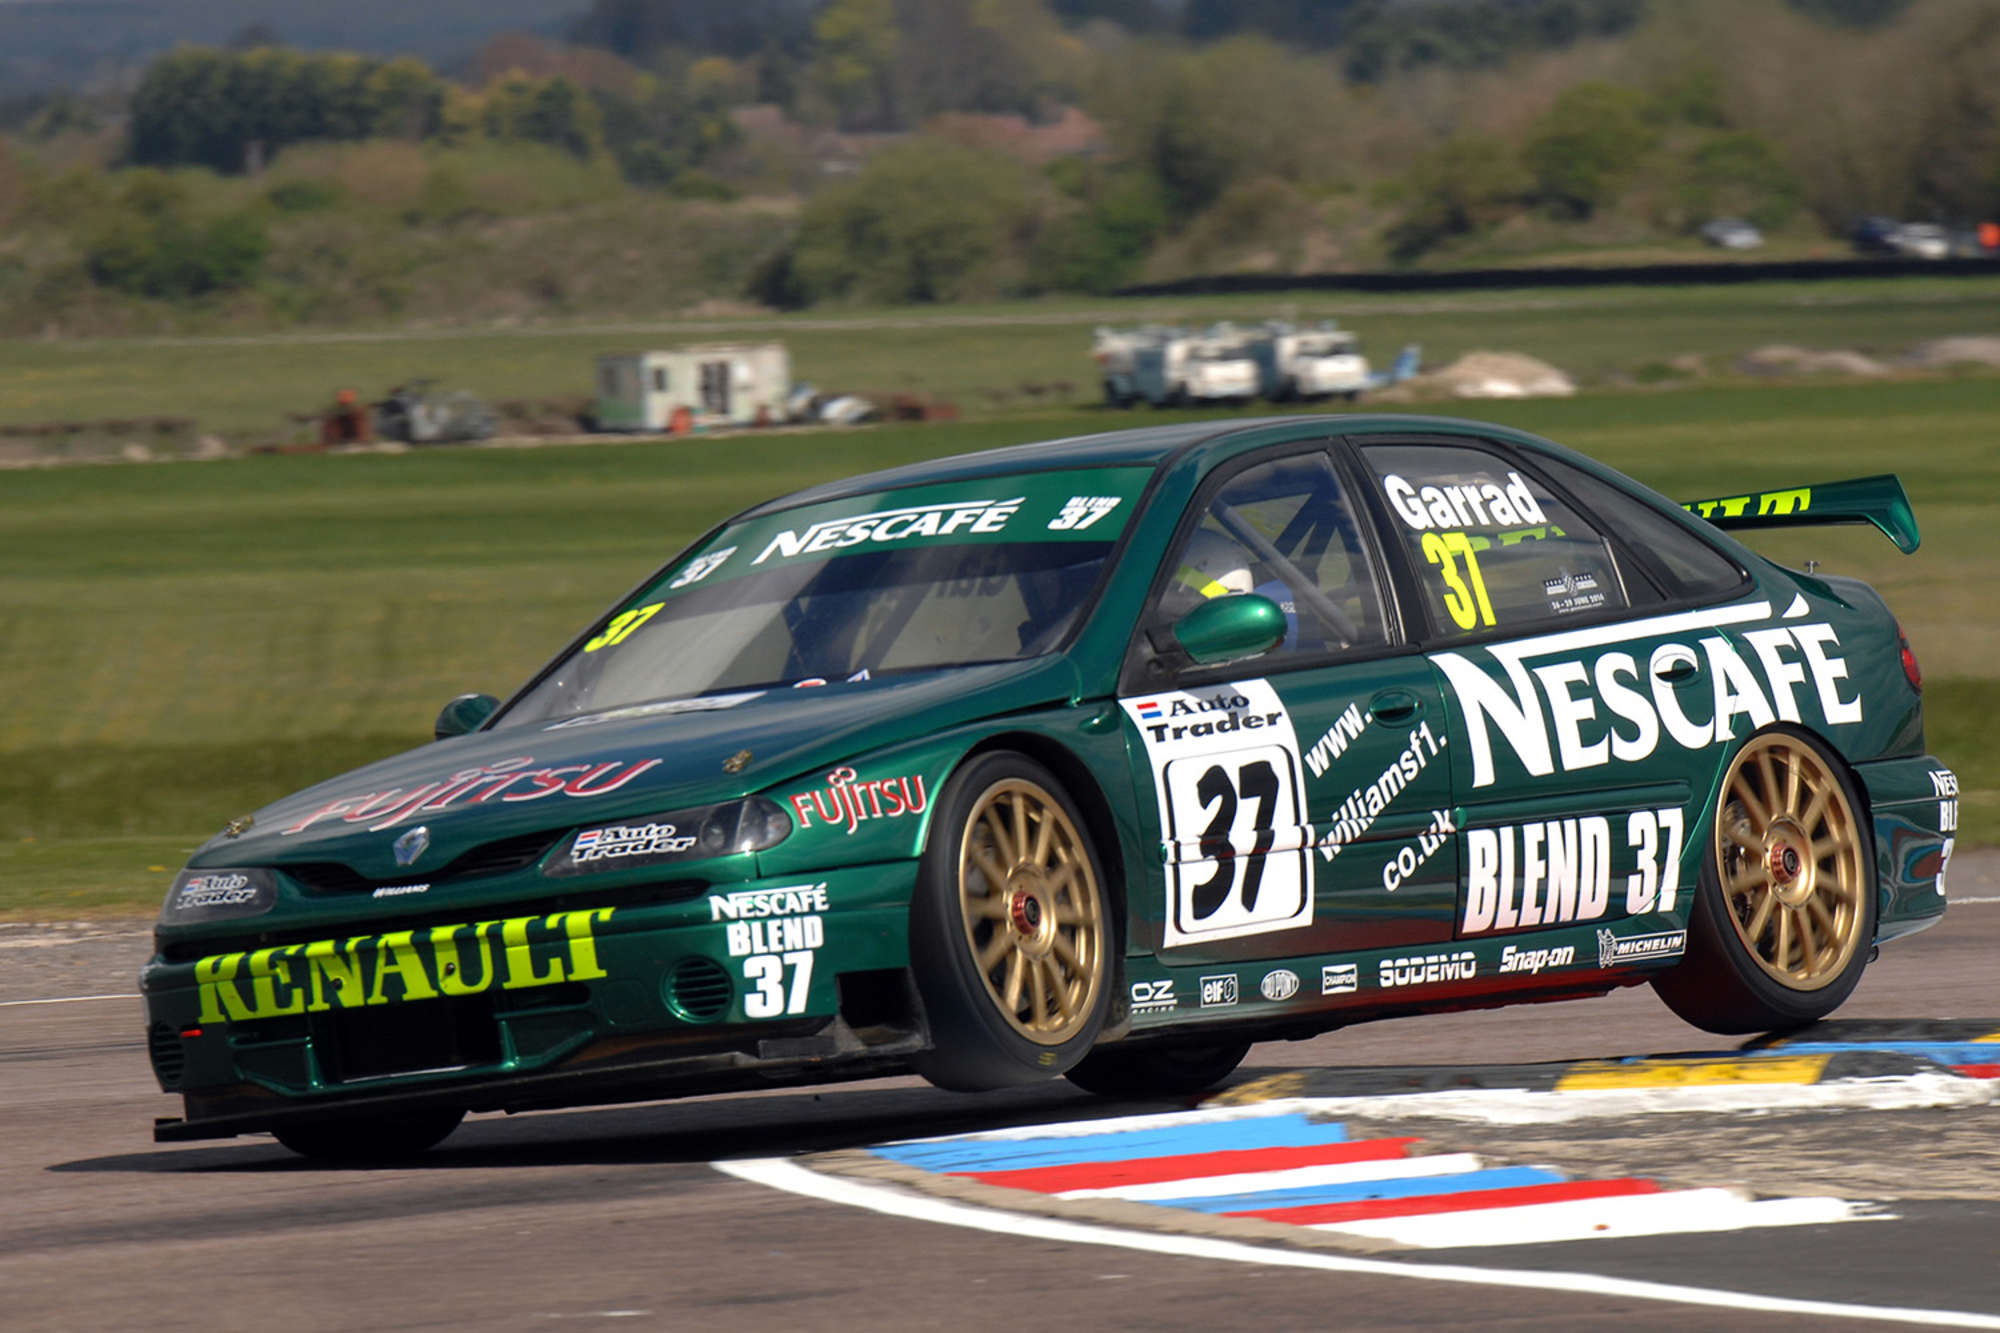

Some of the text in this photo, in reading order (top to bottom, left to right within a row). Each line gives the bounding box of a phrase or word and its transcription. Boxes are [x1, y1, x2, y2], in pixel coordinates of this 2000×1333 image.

[1047, 507, 1113, 530] 37
[1384, 472, 1548, 530] Garrad
[750, 497, 1026, 566] NESCAFÉ
[670, 556, 729, 589] 37
[1421, 532, 1497, 630] 37
[584, 602, 666, 652] 37
[1169, 694, 1249, 717] Auto
[1429, 593, 1864, 788] NESCAFÉ
[1147, 711, 1282, 743] Trader
[1304, 702, 1373, 778] www.
[281, 757, 663, 835] FUJITSU
[789, 768, 928, 834] FUJITSU
[1318, 720, 1448, 862] williamsf1.
[570, 837, 697, 863] Trader
[604, 823, 677, 841] Auto
[1192, 760, 1279, 920] 37
[1383, 808, 1457, 891] co.uk
[203, 873, 248, 889] Auto
[1461, 807, 1685, 935] BLEND 37
[708, 881, 830, 921] NESCAFÉ
[727, 915, 824, 957] BLEND
[1499, 945, 1575, 975] Snap-on
[1616, 935, 1682, 955] MICHELIN
[195, 907, 616, 1024] RENAULT
[743, 950, 815, 1018] 37
[1379, 951, 1477, 988] SODEMO
[1203, 980, 1224, 1003] elf
